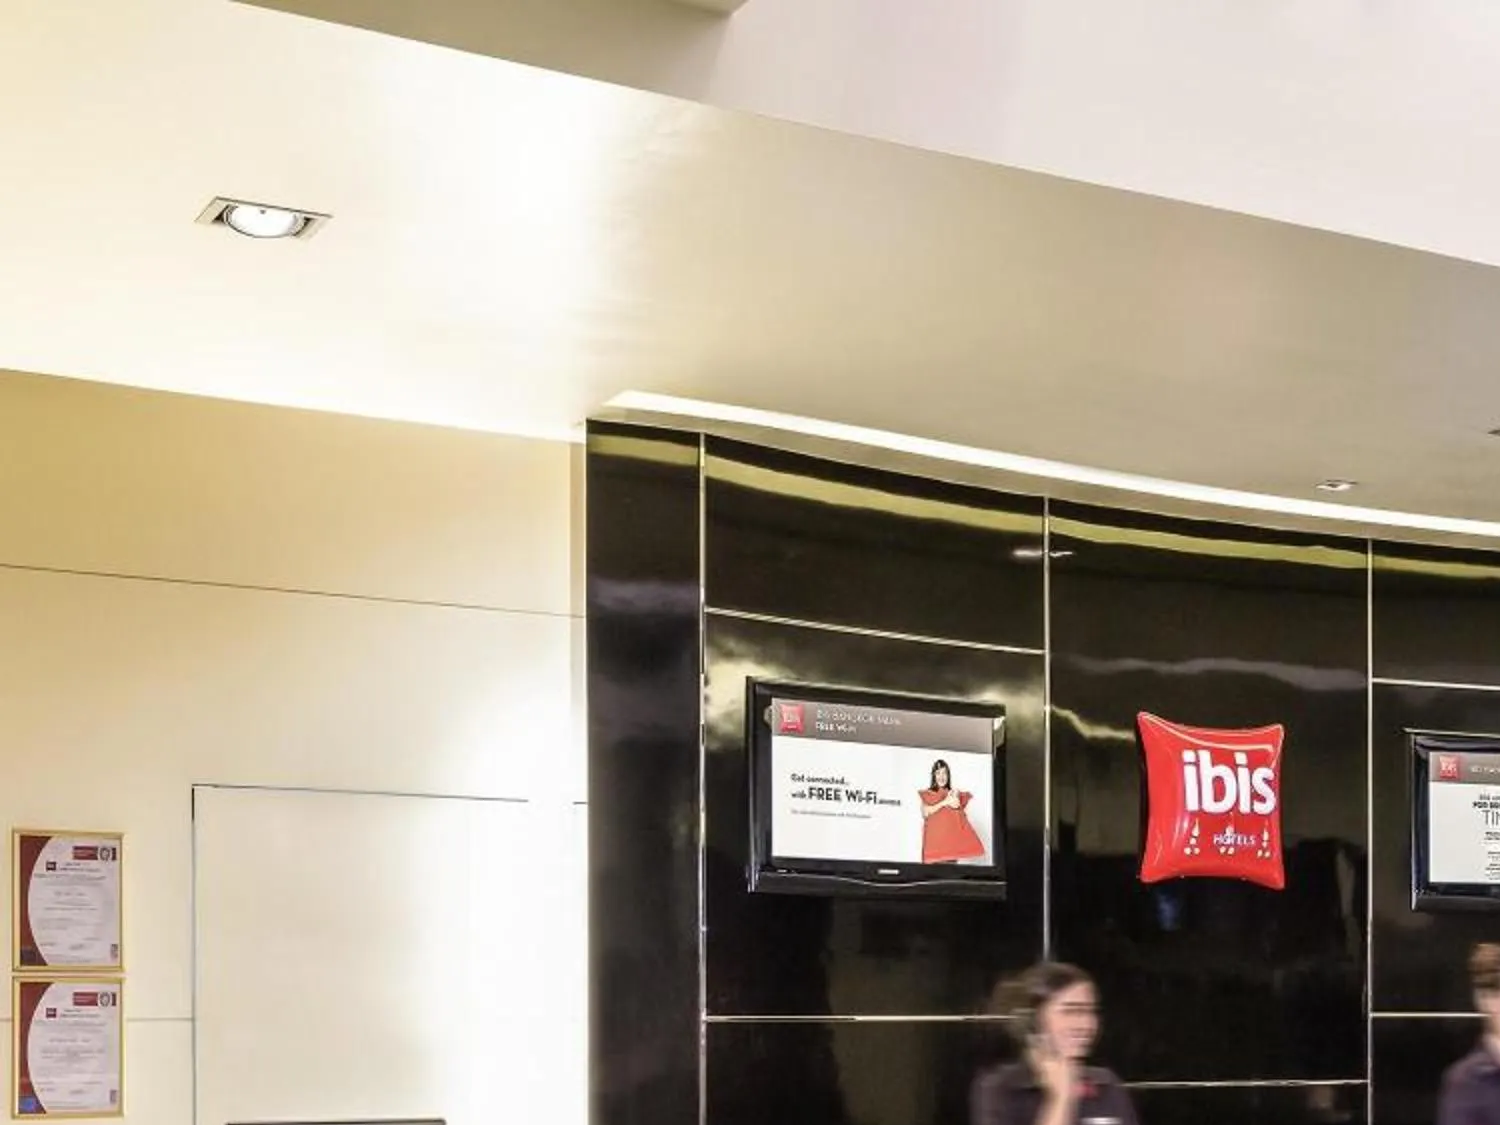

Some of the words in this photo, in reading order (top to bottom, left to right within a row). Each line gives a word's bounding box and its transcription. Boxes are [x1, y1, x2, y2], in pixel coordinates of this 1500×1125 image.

[808, 786, 842, 802] FREE
[845, 789, 877, 805] Wi-Fi
[1182, 749, 1277, 816] ibis
